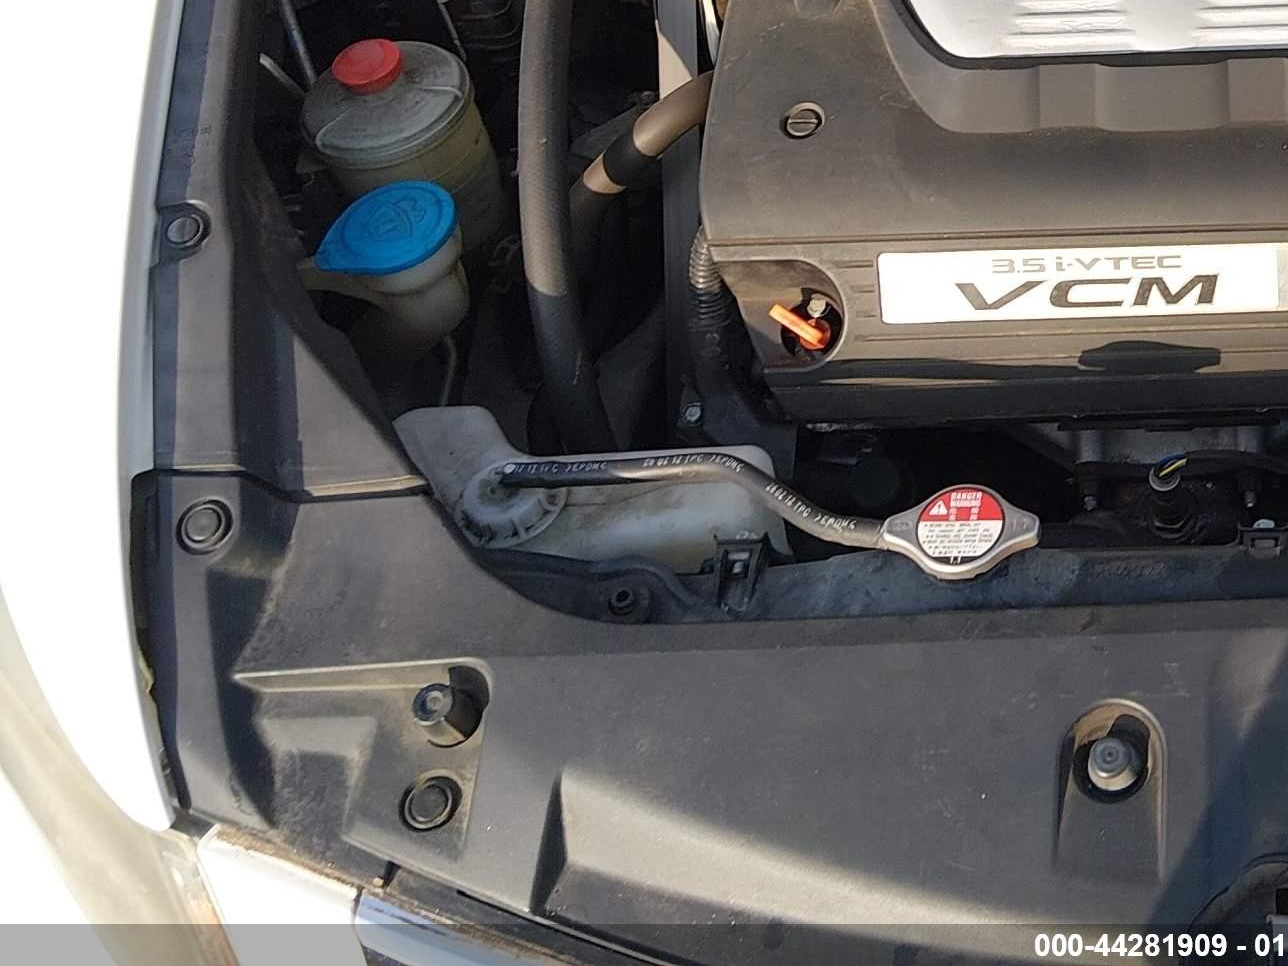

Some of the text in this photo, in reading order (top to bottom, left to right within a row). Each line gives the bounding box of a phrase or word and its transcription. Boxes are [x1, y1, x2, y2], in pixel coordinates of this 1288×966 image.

[991, 254, 1182, 275] 3.5 i-VTEC
[955, 272, 1221, 311] VCM
[950, 492, 983, 500] DANGER
